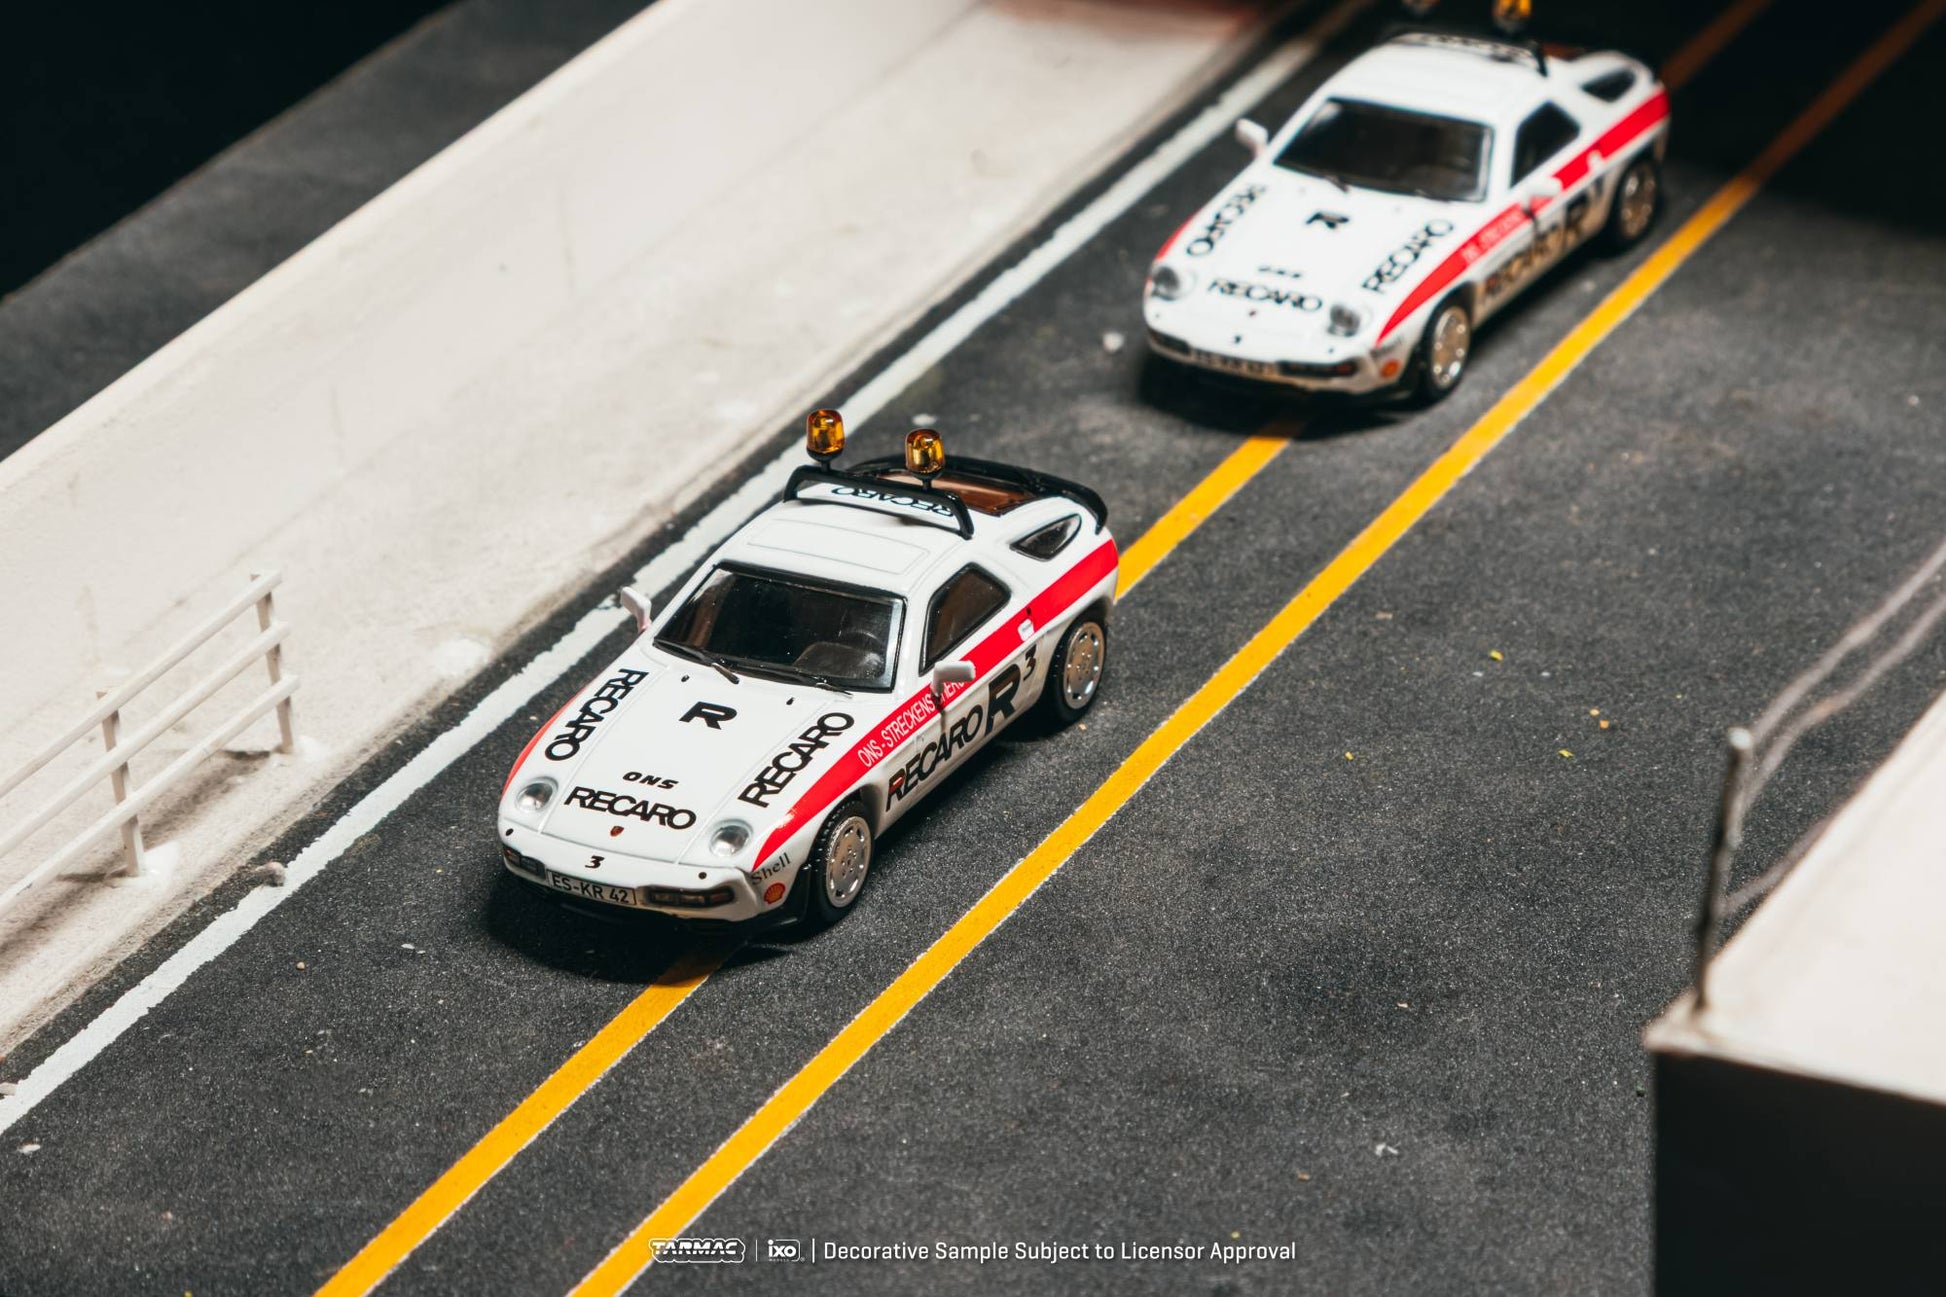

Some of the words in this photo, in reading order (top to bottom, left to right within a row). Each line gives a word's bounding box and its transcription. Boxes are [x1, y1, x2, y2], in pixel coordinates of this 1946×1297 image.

[1022, 643, 1037, 681] 3
[545, 668, 649, 761] RECARO
[678, 701, 738, 730] R
[984, 663, 1022, 738] R
[737, 712, 855, 808] RECARO
[886, 704, 984, 812] RECARO
[622, 771, 679, 789] ONS
[563, 786, 697, 830] RECARO
[584, 855, 605, 869] 3
[751, 852, 790, 885] Shell
[608, 888, 630, 904] 42
